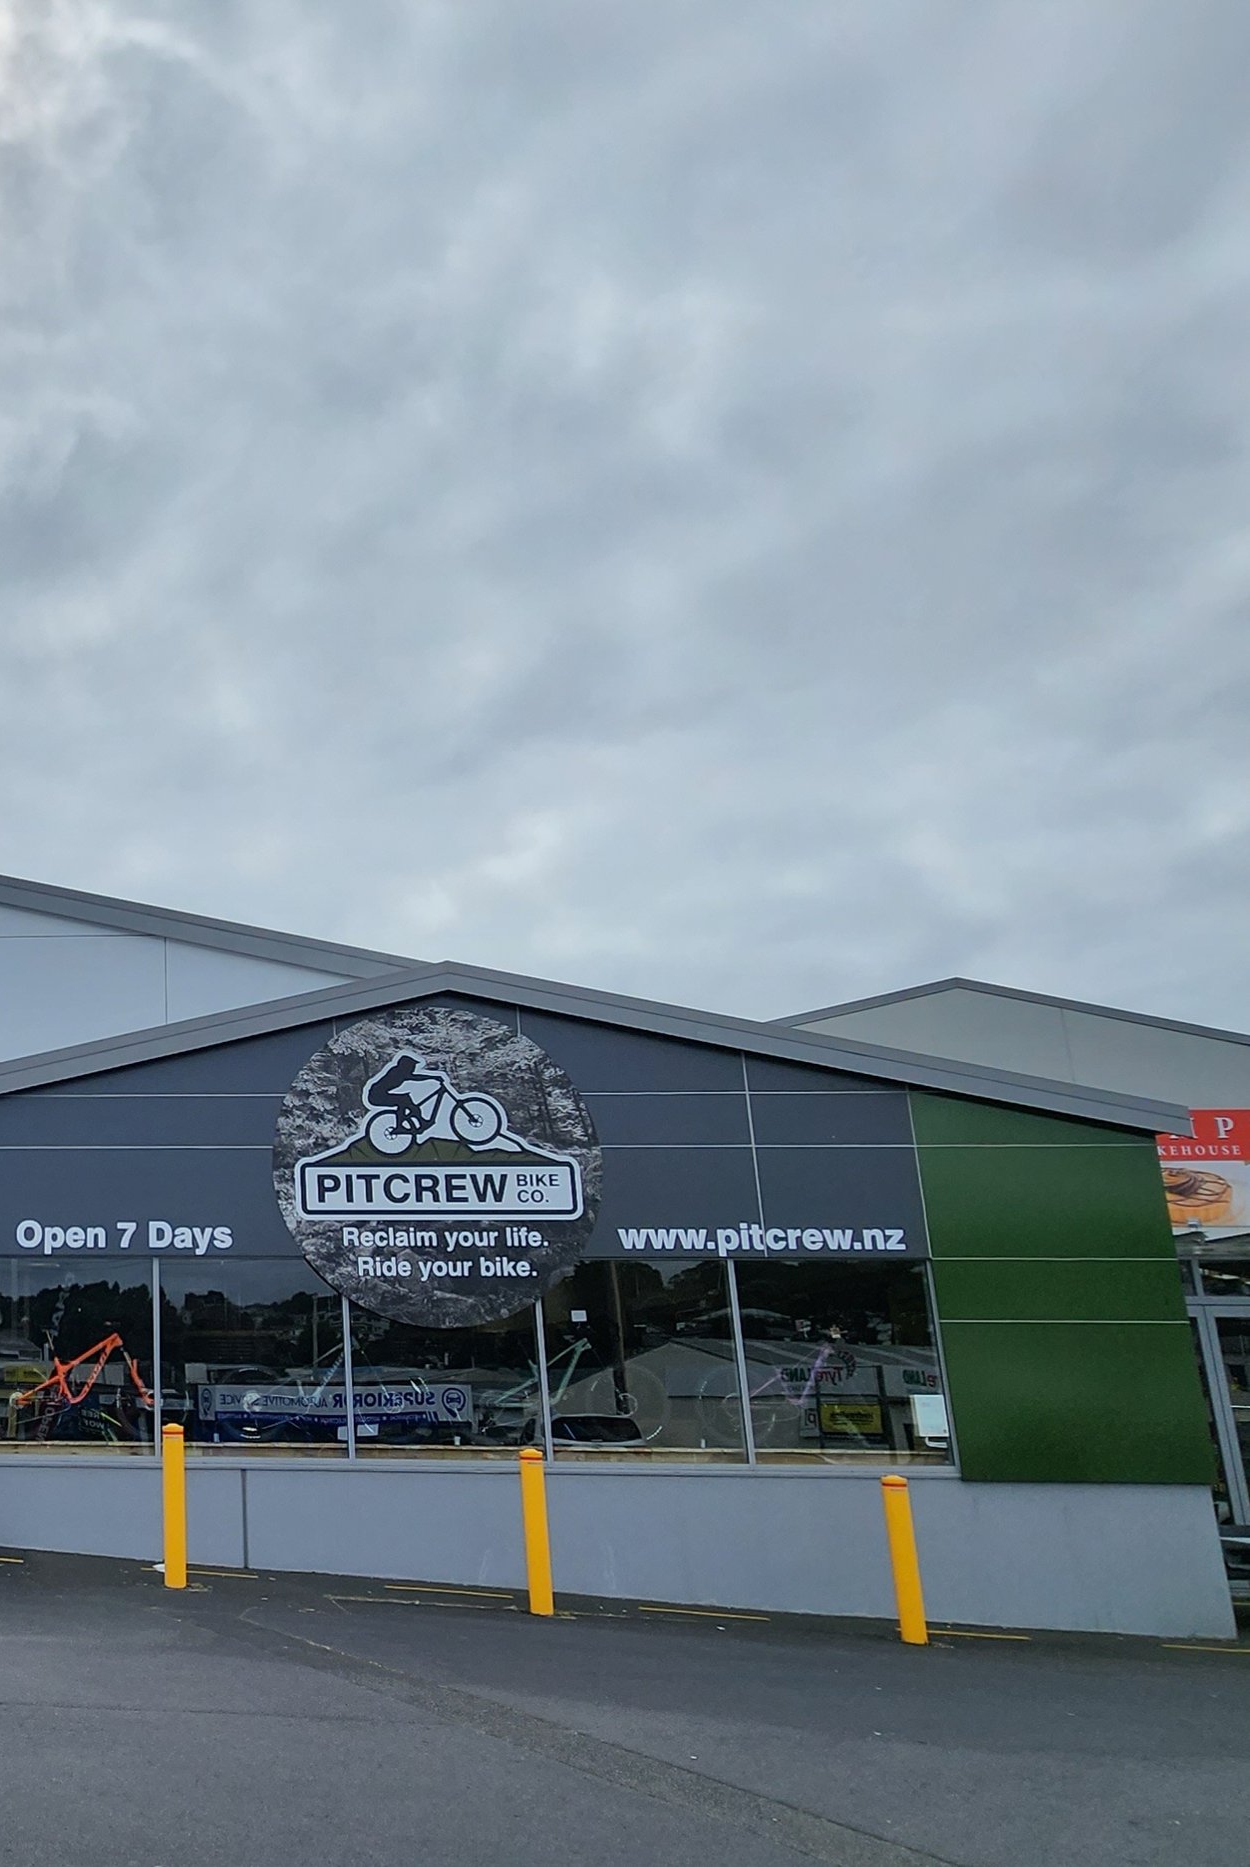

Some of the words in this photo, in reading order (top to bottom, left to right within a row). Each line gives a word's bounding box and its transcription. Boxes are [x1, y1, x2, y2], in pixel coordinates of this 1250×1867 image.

[317, 1173, 507, 1203] PITCREW
[516, 1174, 559, 1187] BIKE
[517, 1189, 549, 1203] CO.
[16, 1219, 106, 1255] Open
[116, 1221, 137, 1248] 7
[148, 1220, 233, 1255] Days
[342, 1227, 438, 1247] Reclaim
[444, 1231, 498, 1251] your
[505, 1227, 549, 1247] life.
[617, 1222, 906, 1256] www.pitcrew.nz
[357, 1256, 412, 1277] Ride
[418, 1260, 472, 1281] your
[480, 1256, 538, 1277] bike.
